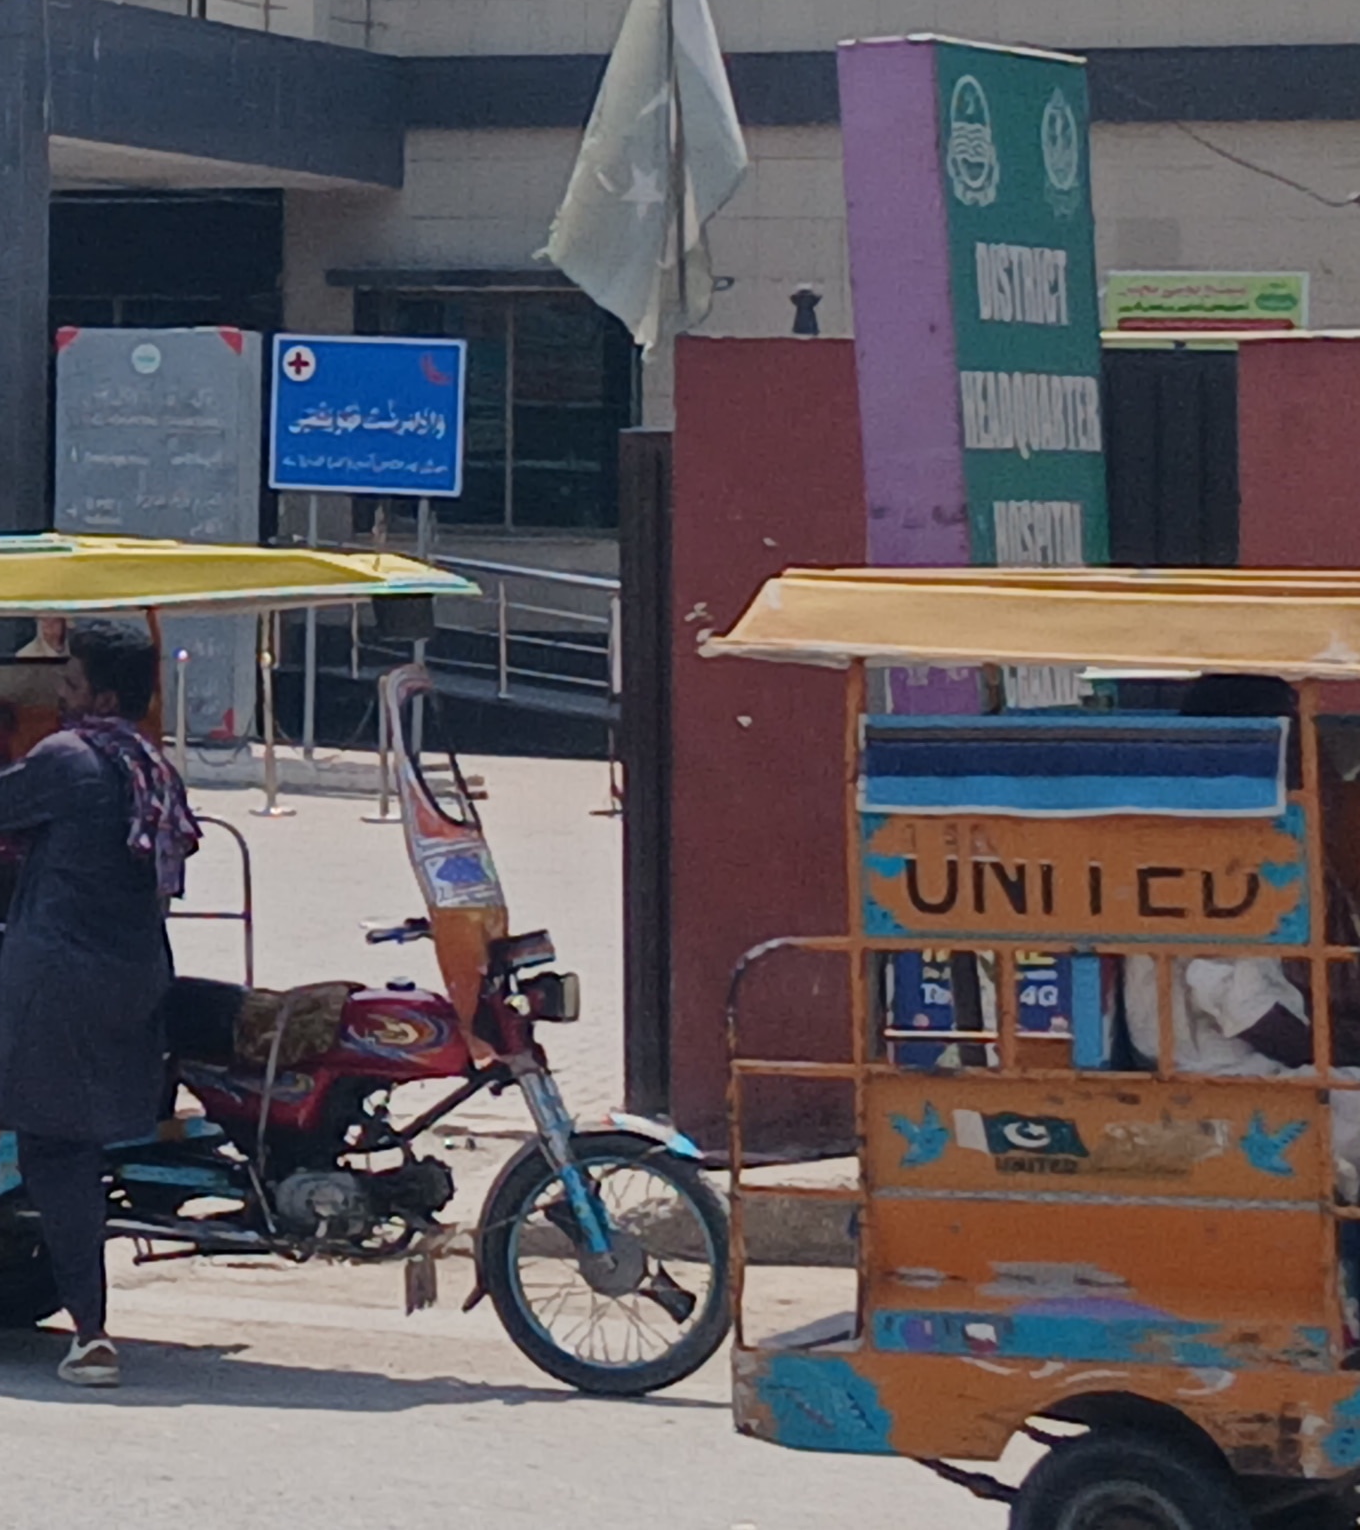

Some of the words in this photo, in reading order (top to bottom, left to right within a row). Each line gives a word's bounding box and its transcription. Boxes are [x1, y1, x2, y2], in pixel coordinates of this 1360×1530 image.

[975, 241, 1069, 327] DISTRICT
[959, 370, 1104, 461] HEADQUARTER
[902, 834, 1262, 919] UNITED
